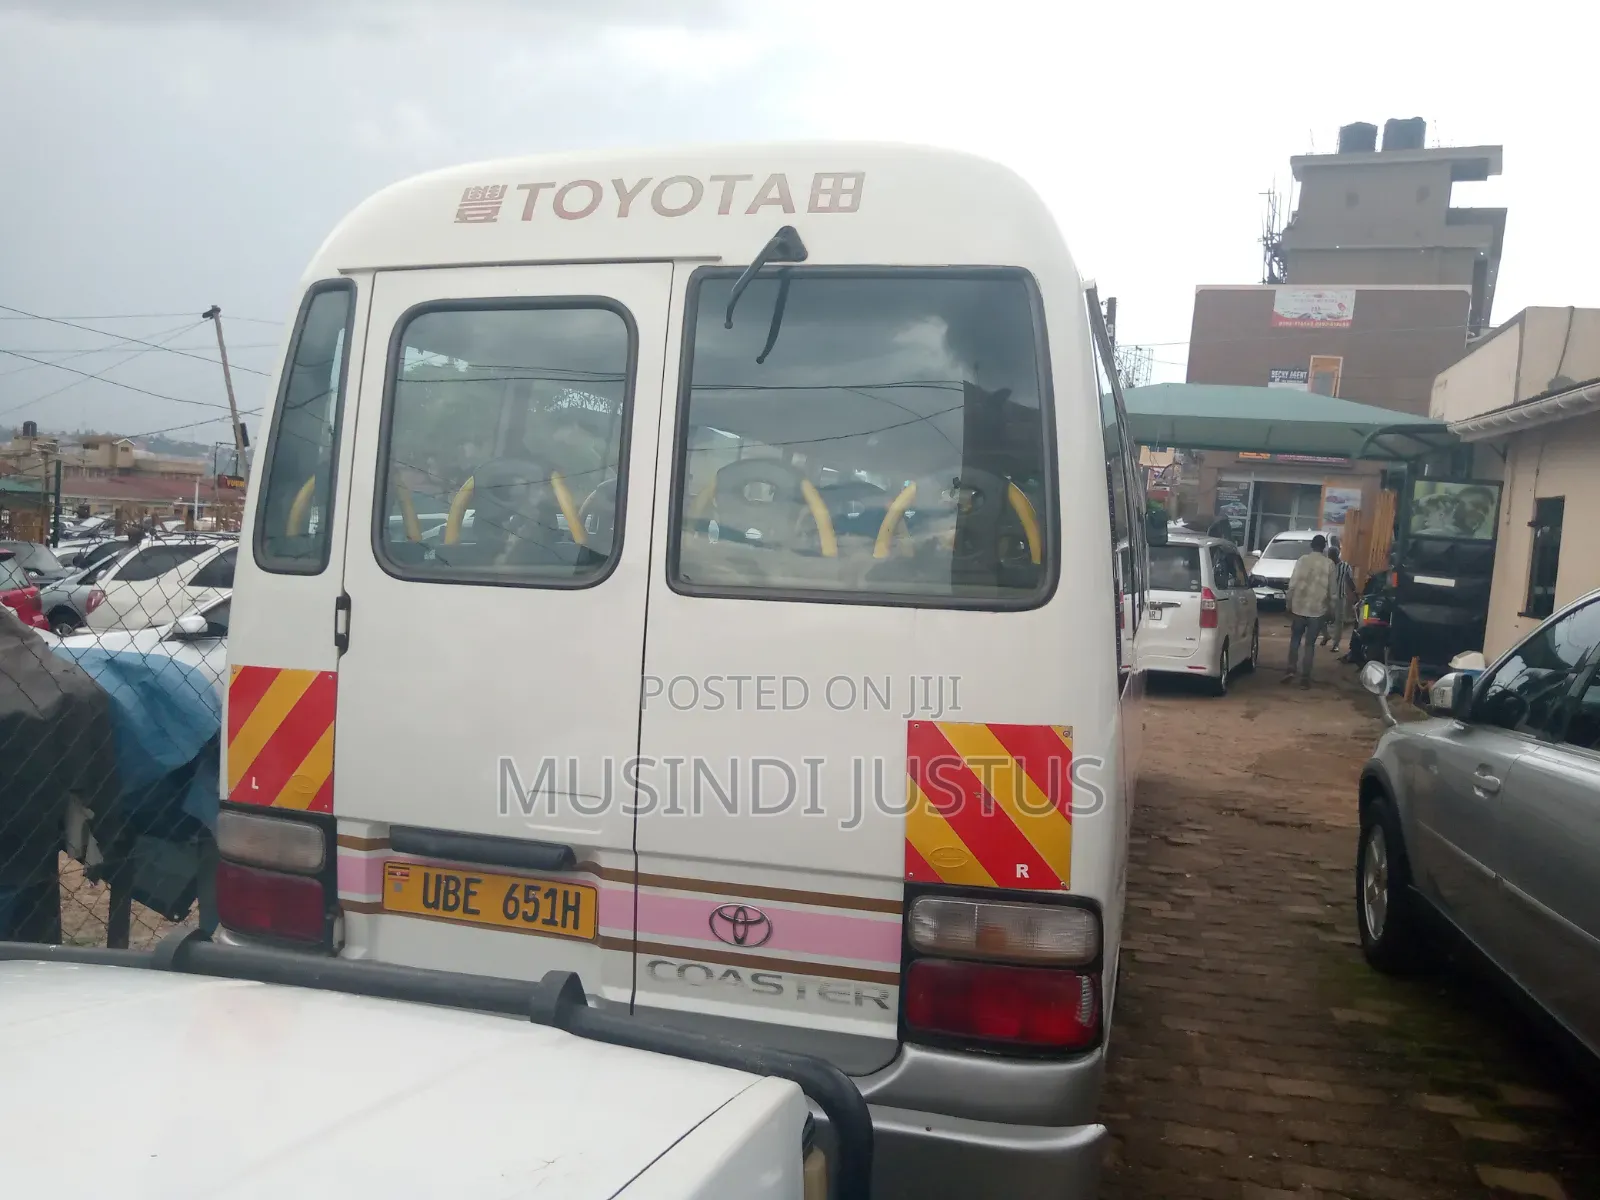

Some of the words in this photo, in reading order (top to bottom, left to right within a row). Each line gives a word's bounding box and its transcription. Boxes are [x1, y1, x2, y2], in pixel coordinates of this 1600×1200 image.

[516, 173, 796, 221] TOYOTA
[252, 777, 259, 789] L
[1016, 863, 1029, 878] R
[422, 871, 483, 916] UBE
[502, 883, 581, 930] 651H
[647, 959, 891, 1010] COASTER
